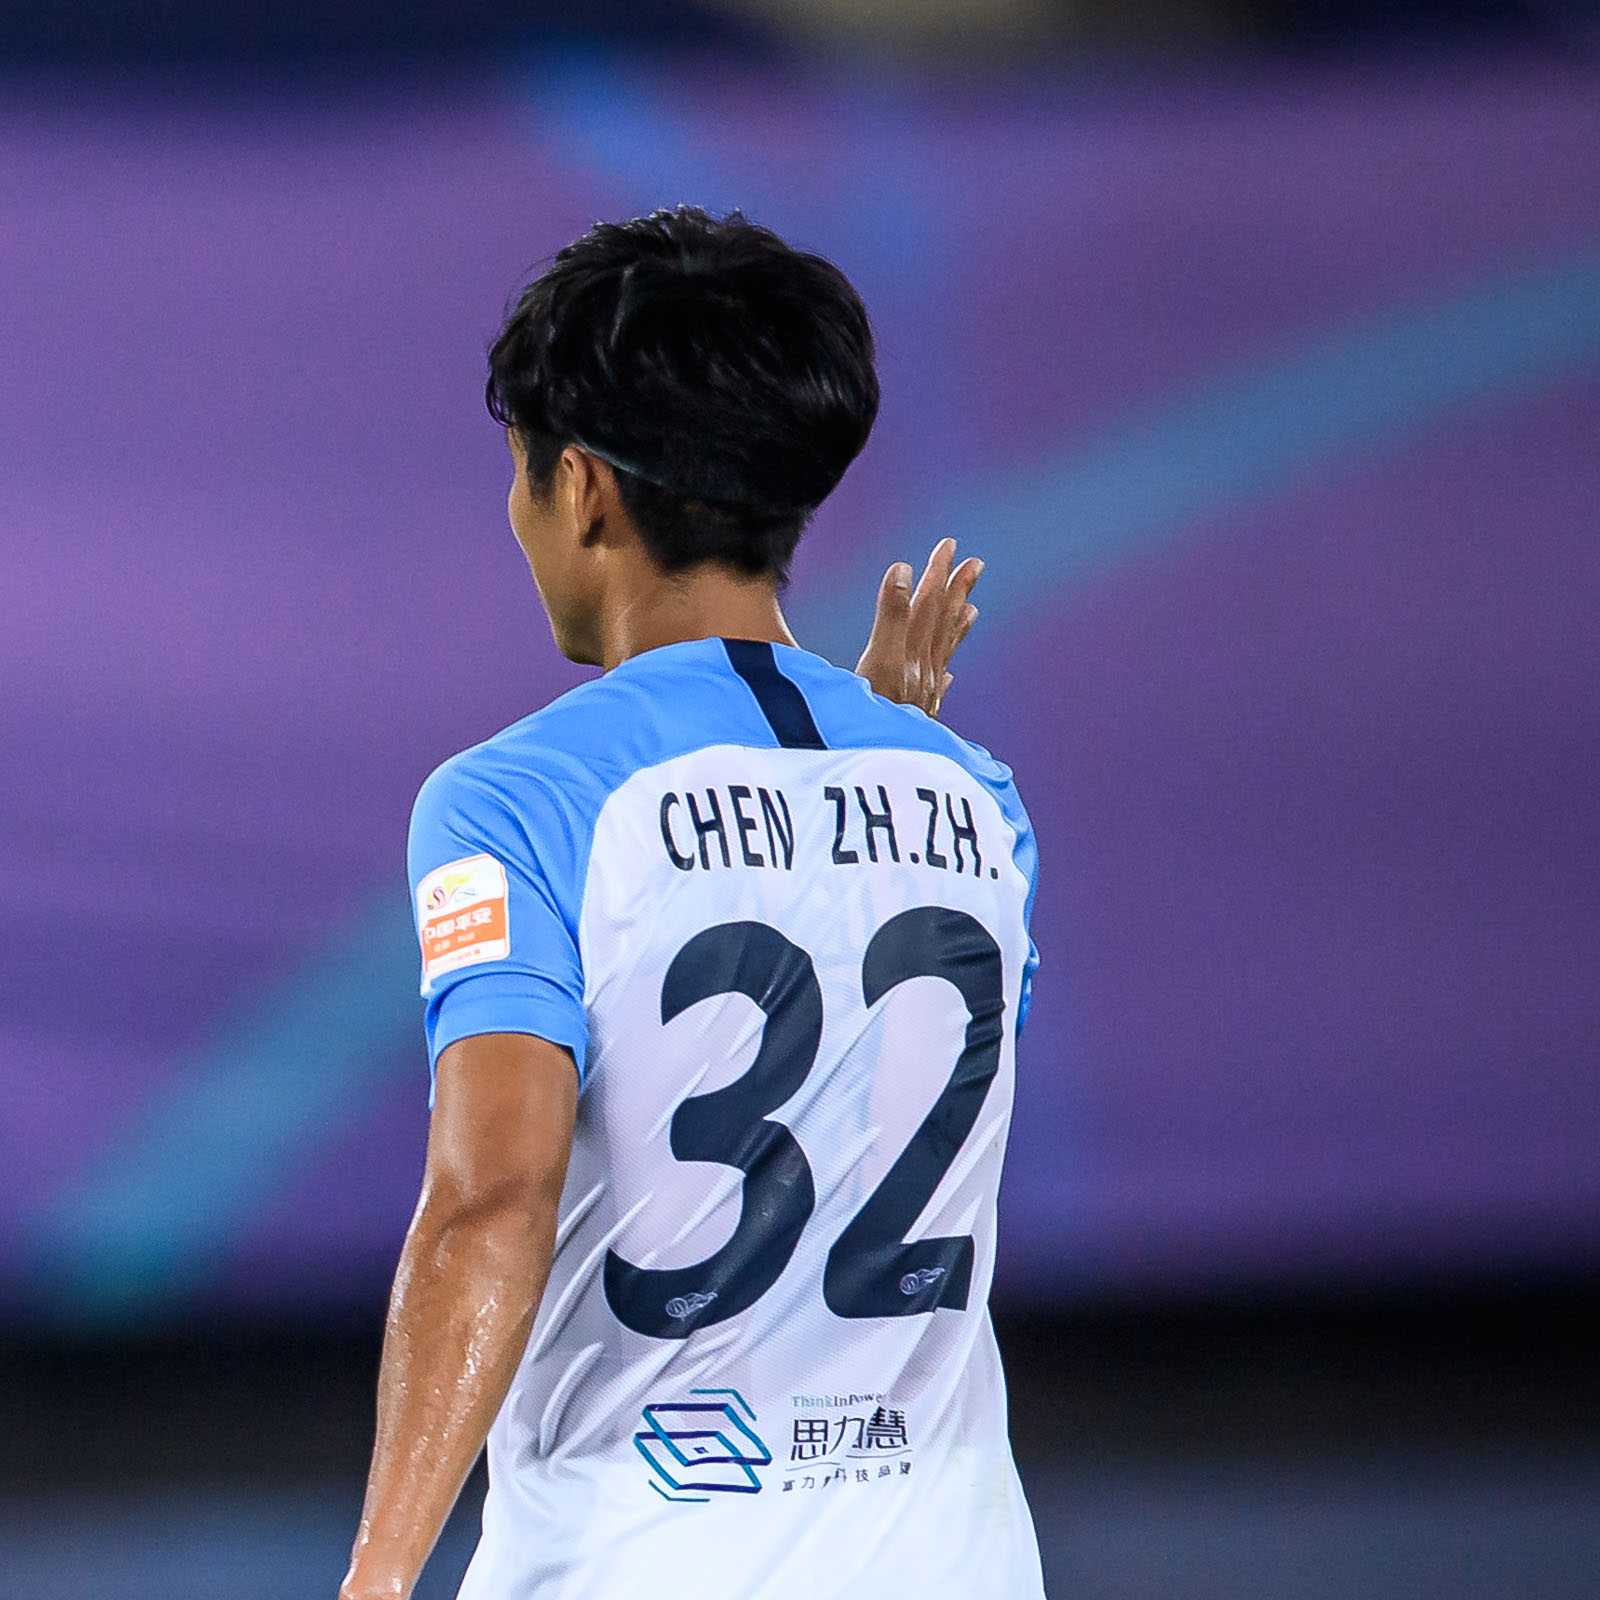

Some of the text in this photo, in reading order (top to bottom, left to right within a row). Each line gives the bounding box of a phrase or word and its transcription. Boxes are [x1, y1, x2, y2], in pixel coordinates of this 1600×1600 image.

[660, 785, 999, 880] CHEN ZH.ZH.
[603, 906, 1006, 1339] 32
